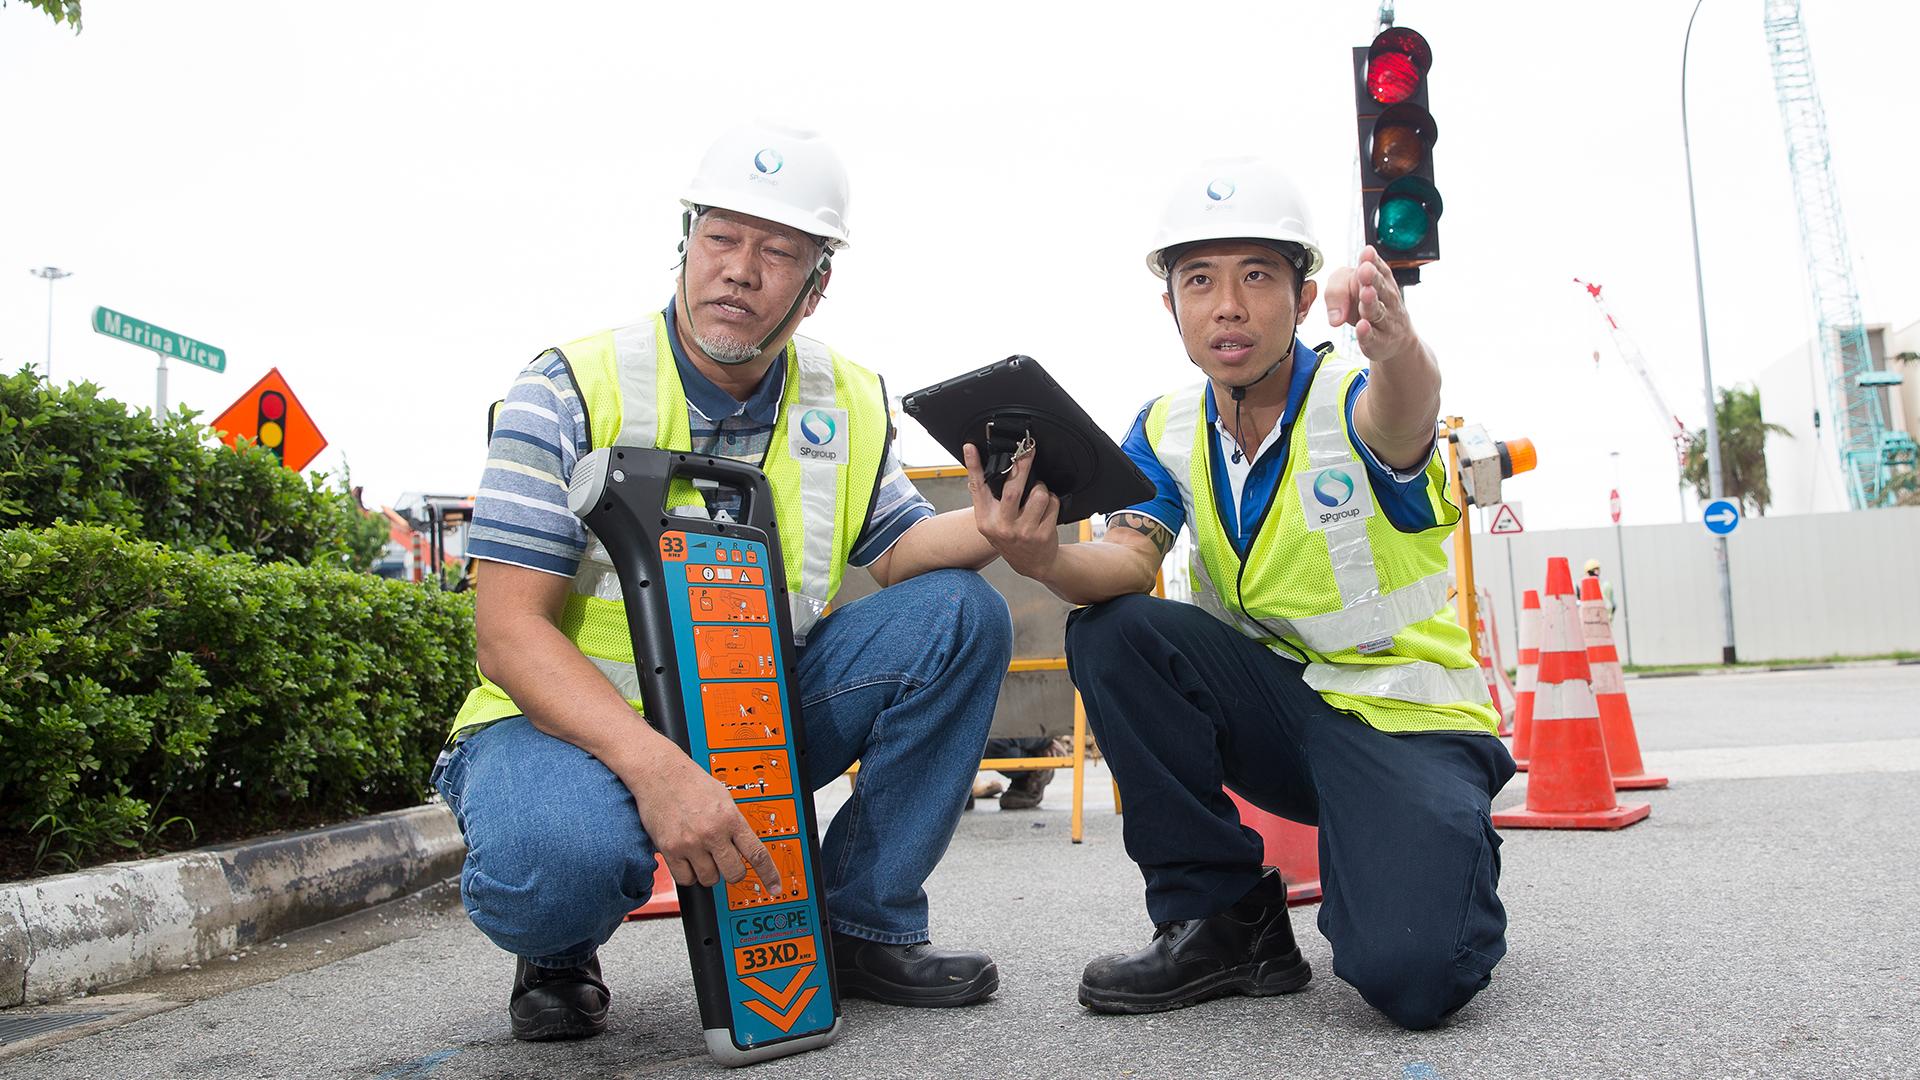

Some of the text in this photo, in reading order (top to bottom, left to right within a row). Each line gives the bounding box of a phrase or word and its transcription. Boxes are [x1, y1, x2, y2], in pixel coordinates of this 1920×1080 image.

[104, 311, 220, 368] Marina View
[662, 536, 684, 553] 33
[747, 543, 753, 551] G
[743, 942, 799, 970] 33XD
